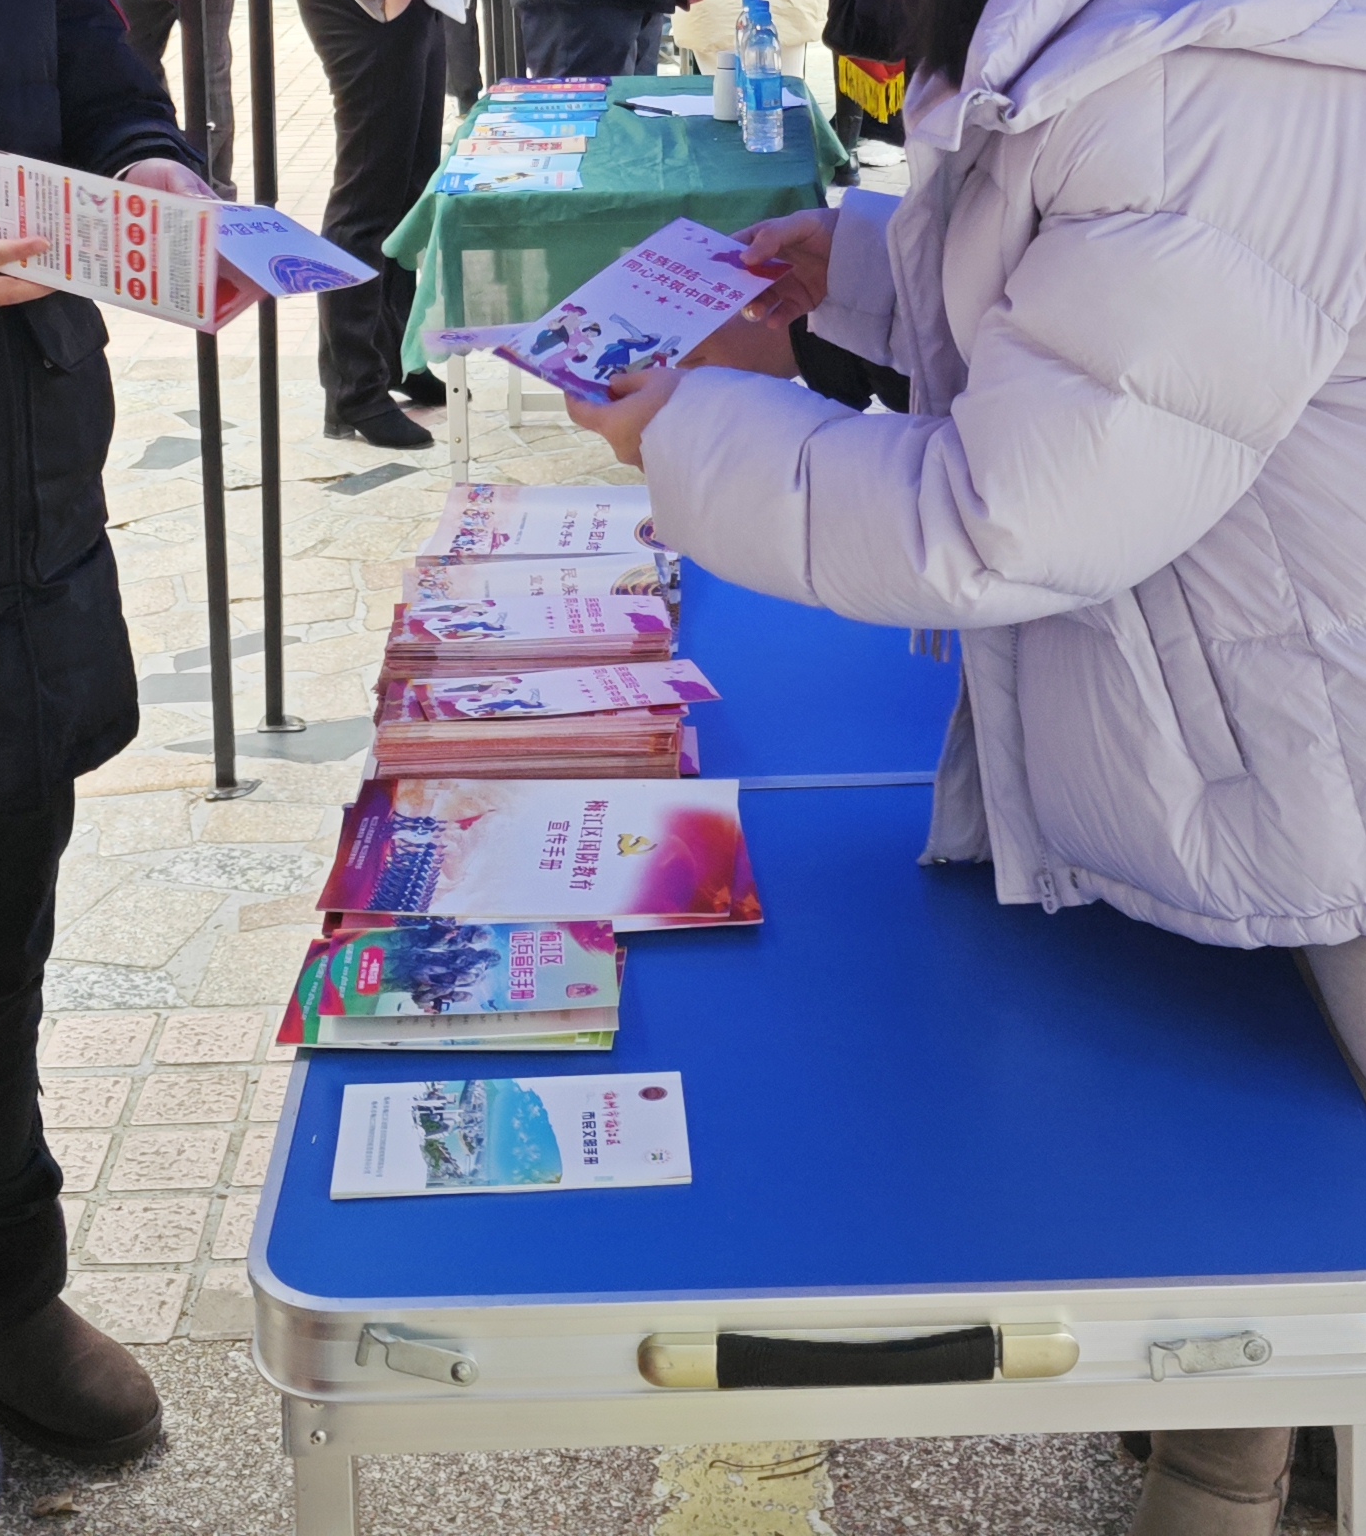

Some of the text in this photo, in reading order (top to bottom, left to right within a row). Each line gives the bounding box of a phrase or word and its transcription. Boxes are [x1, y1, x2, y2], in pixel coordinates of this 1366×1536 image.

[622, 259, 733, 311] 同心共筑中国梦
[637, 248, 746, 302] 民族团结一家亲
[539, 819, 572, 872] 宣传手册
[568, 799, 610, 893] 梅江区国防教育
